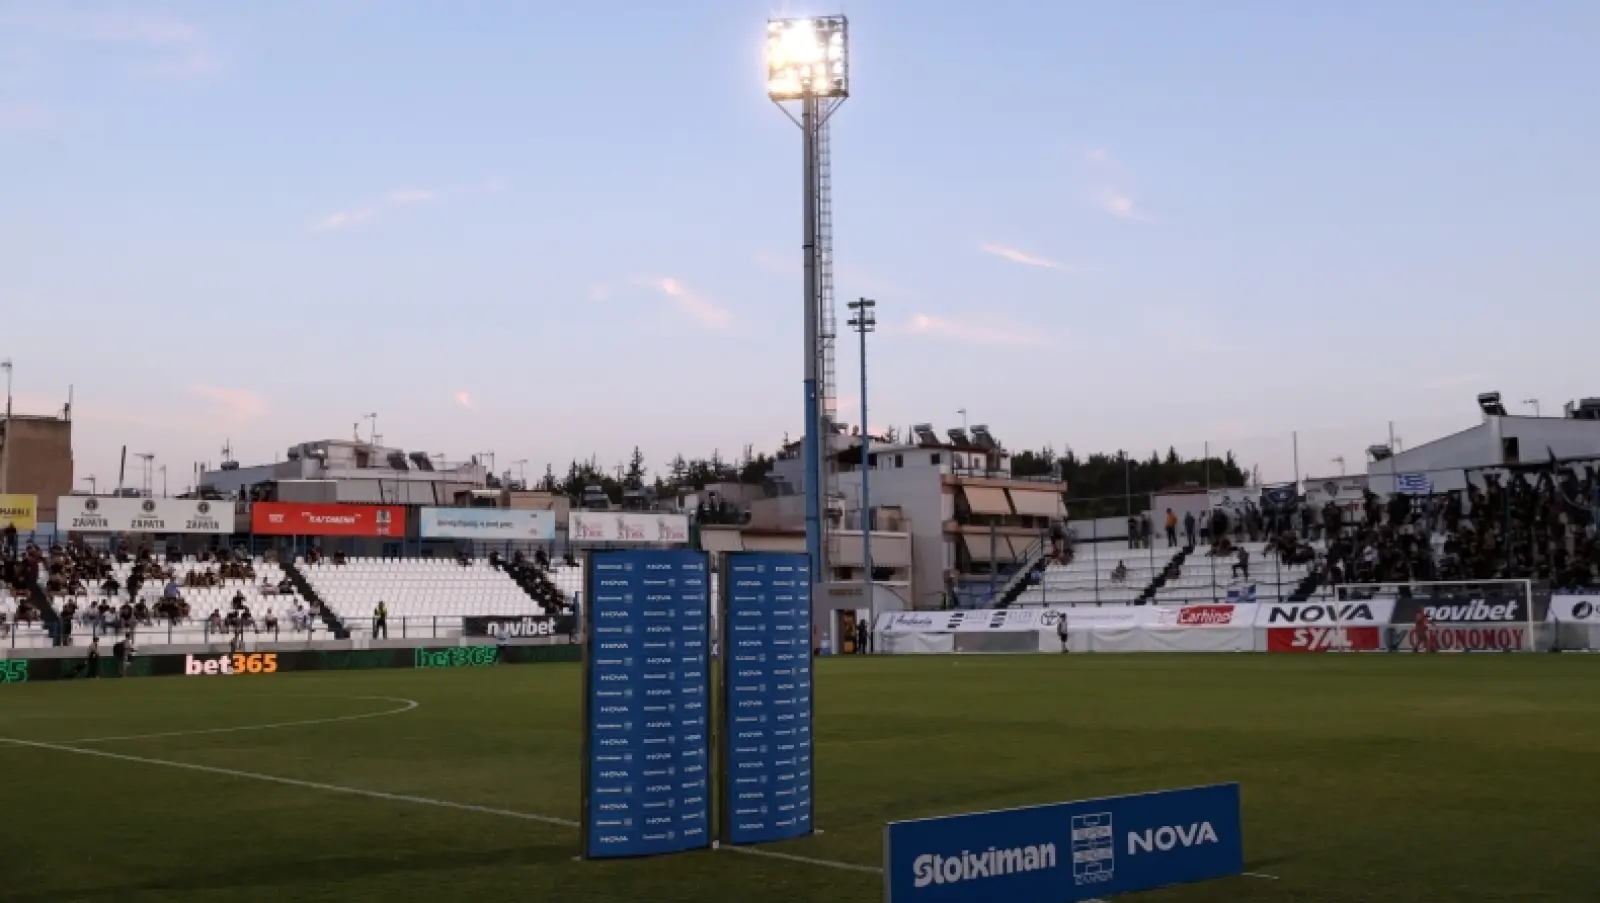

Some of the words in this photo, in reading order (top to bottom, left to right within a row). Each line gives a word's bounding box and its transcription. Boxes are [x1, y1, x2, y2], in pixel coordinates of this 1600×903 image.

[1268, 603, 1373, 622] NOVA
[1291, 628, 1353, 650] SYM
[185, 653, 278, 676] bet365
[414, 645, 498, 668] bet365
[1128, 821, 1218, 855] NOVA
[913, 842, 1056, 887] Stoiximan
